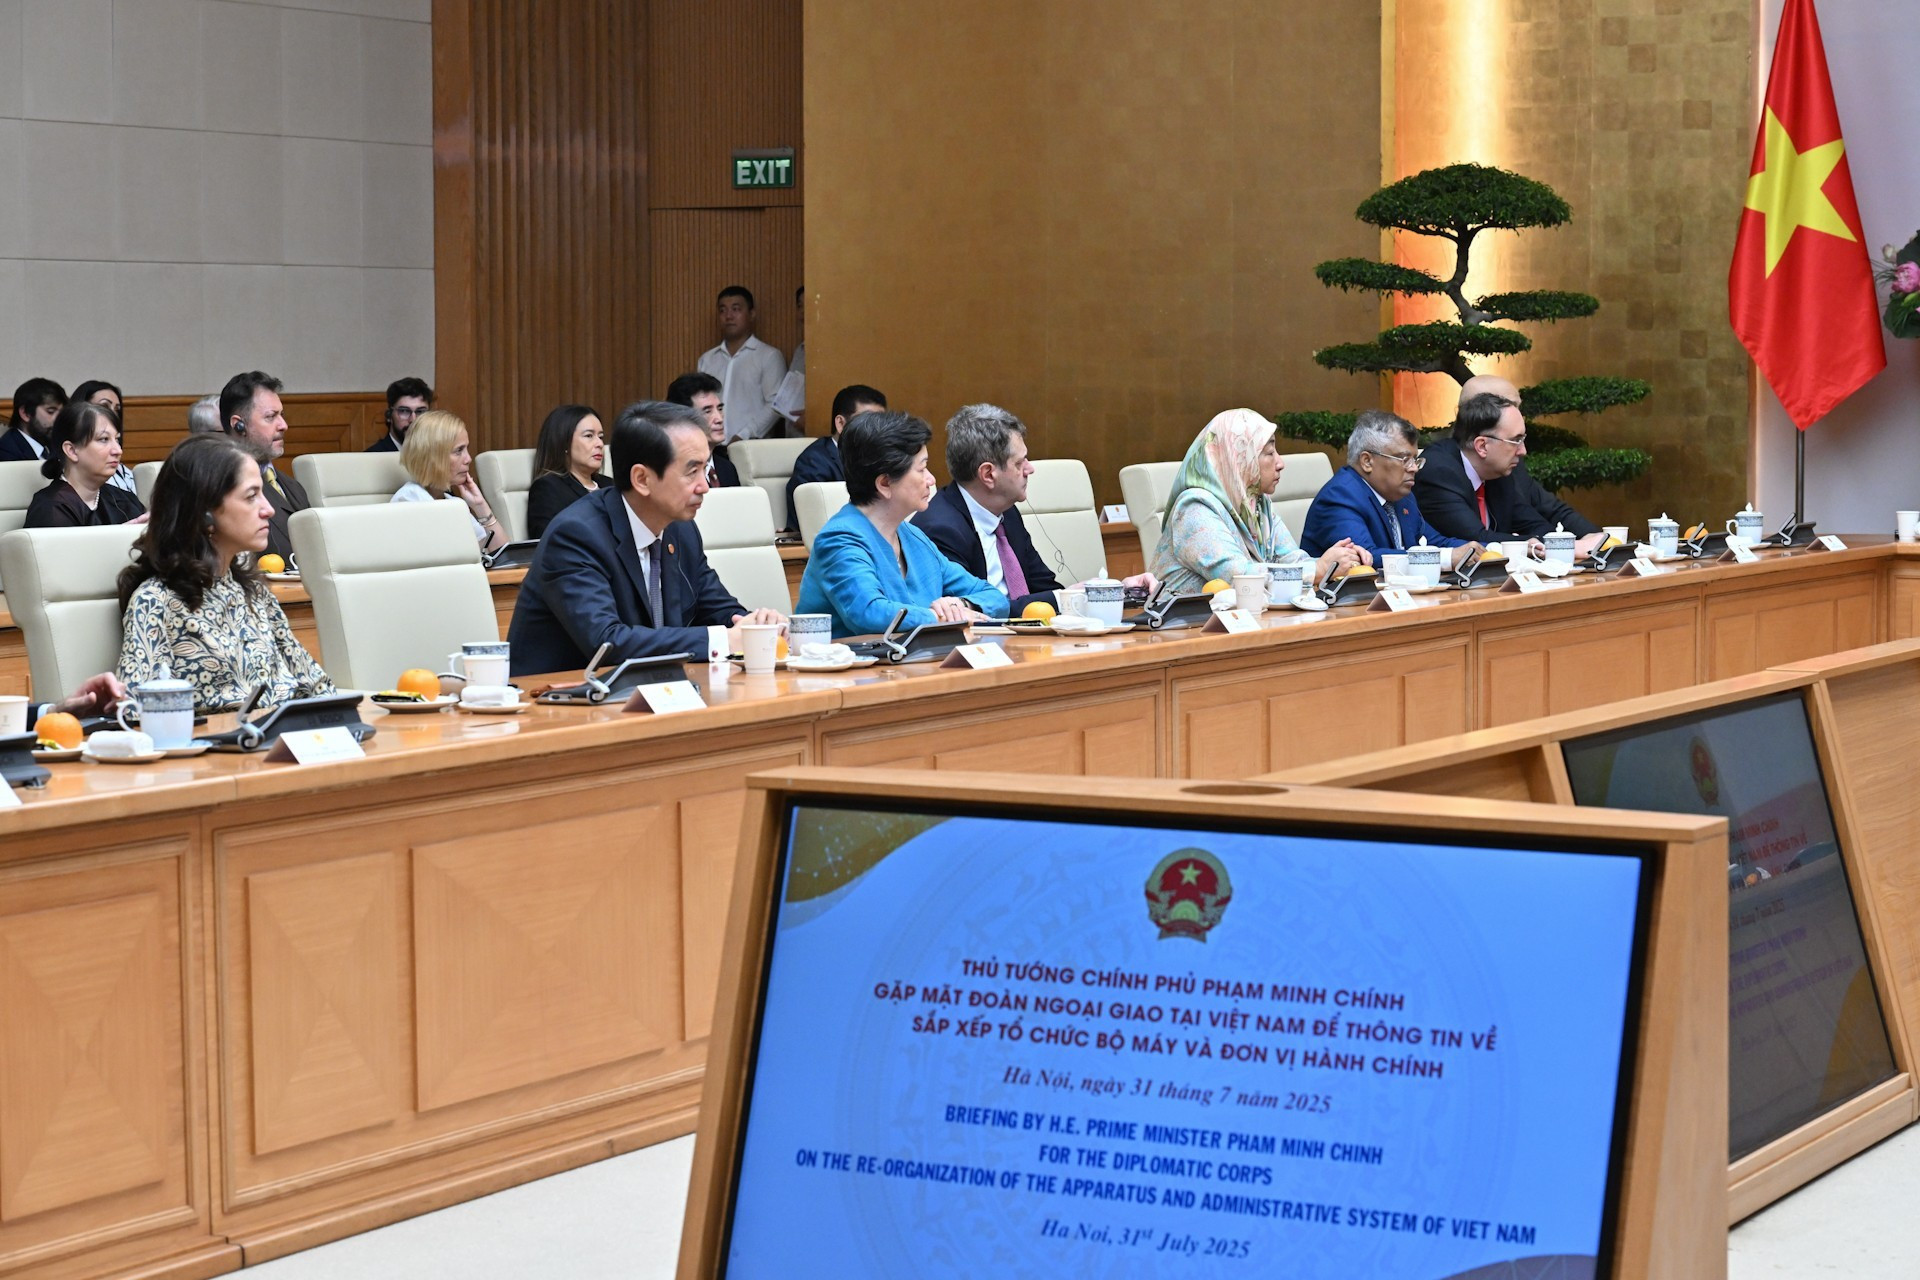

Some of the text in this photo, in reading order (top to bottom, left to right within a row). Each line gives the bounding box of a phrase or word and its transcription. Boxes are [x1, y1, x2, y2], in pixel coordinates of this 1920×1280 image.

[736, 159, 790, 185] EXIT
[962, 956, 1404, 1011] THỦ TƯỚNG CHÍNH PHỦ PHẠM MINH CHÍNH
[874, 980, 1497, 1051] GẶP MẶT ĐOÀN NGOẠI GIAO TẠI VIỆT NAM ĐỂ THÔNG TIN VỀ
[912, 1009, 1443, 1079] SẮP XẾP TỔ CHỨC BỘ MÁY VÀ ĐƠN VỊ HÀNH CHÍNH
[1003, 1066, 1332, 1113] Hà Nội, ngày 31 tháng 7 năm 2025
[945, 1104, 1383, 1165] BRIEFING BY H.E. PRIME MINISTER PHAM MINH CHINH
[1039, 1144, 1272, 1186] FOR THE DIPLOMATIC CORPS
[796, 1148, 1536, 1245] ON THE RE-ORGANIZATION OF THE APPARATUS AND ADMINISTRATIVE SYSTEM OF VIET NAM
[1041, 1219, 1069, 1238] Ha
[1074, 1223, 1112, 1245] Noi,
[1156, 1232, 1199, 1257] July
[1204, 1237, 1251, 1258] 2025
